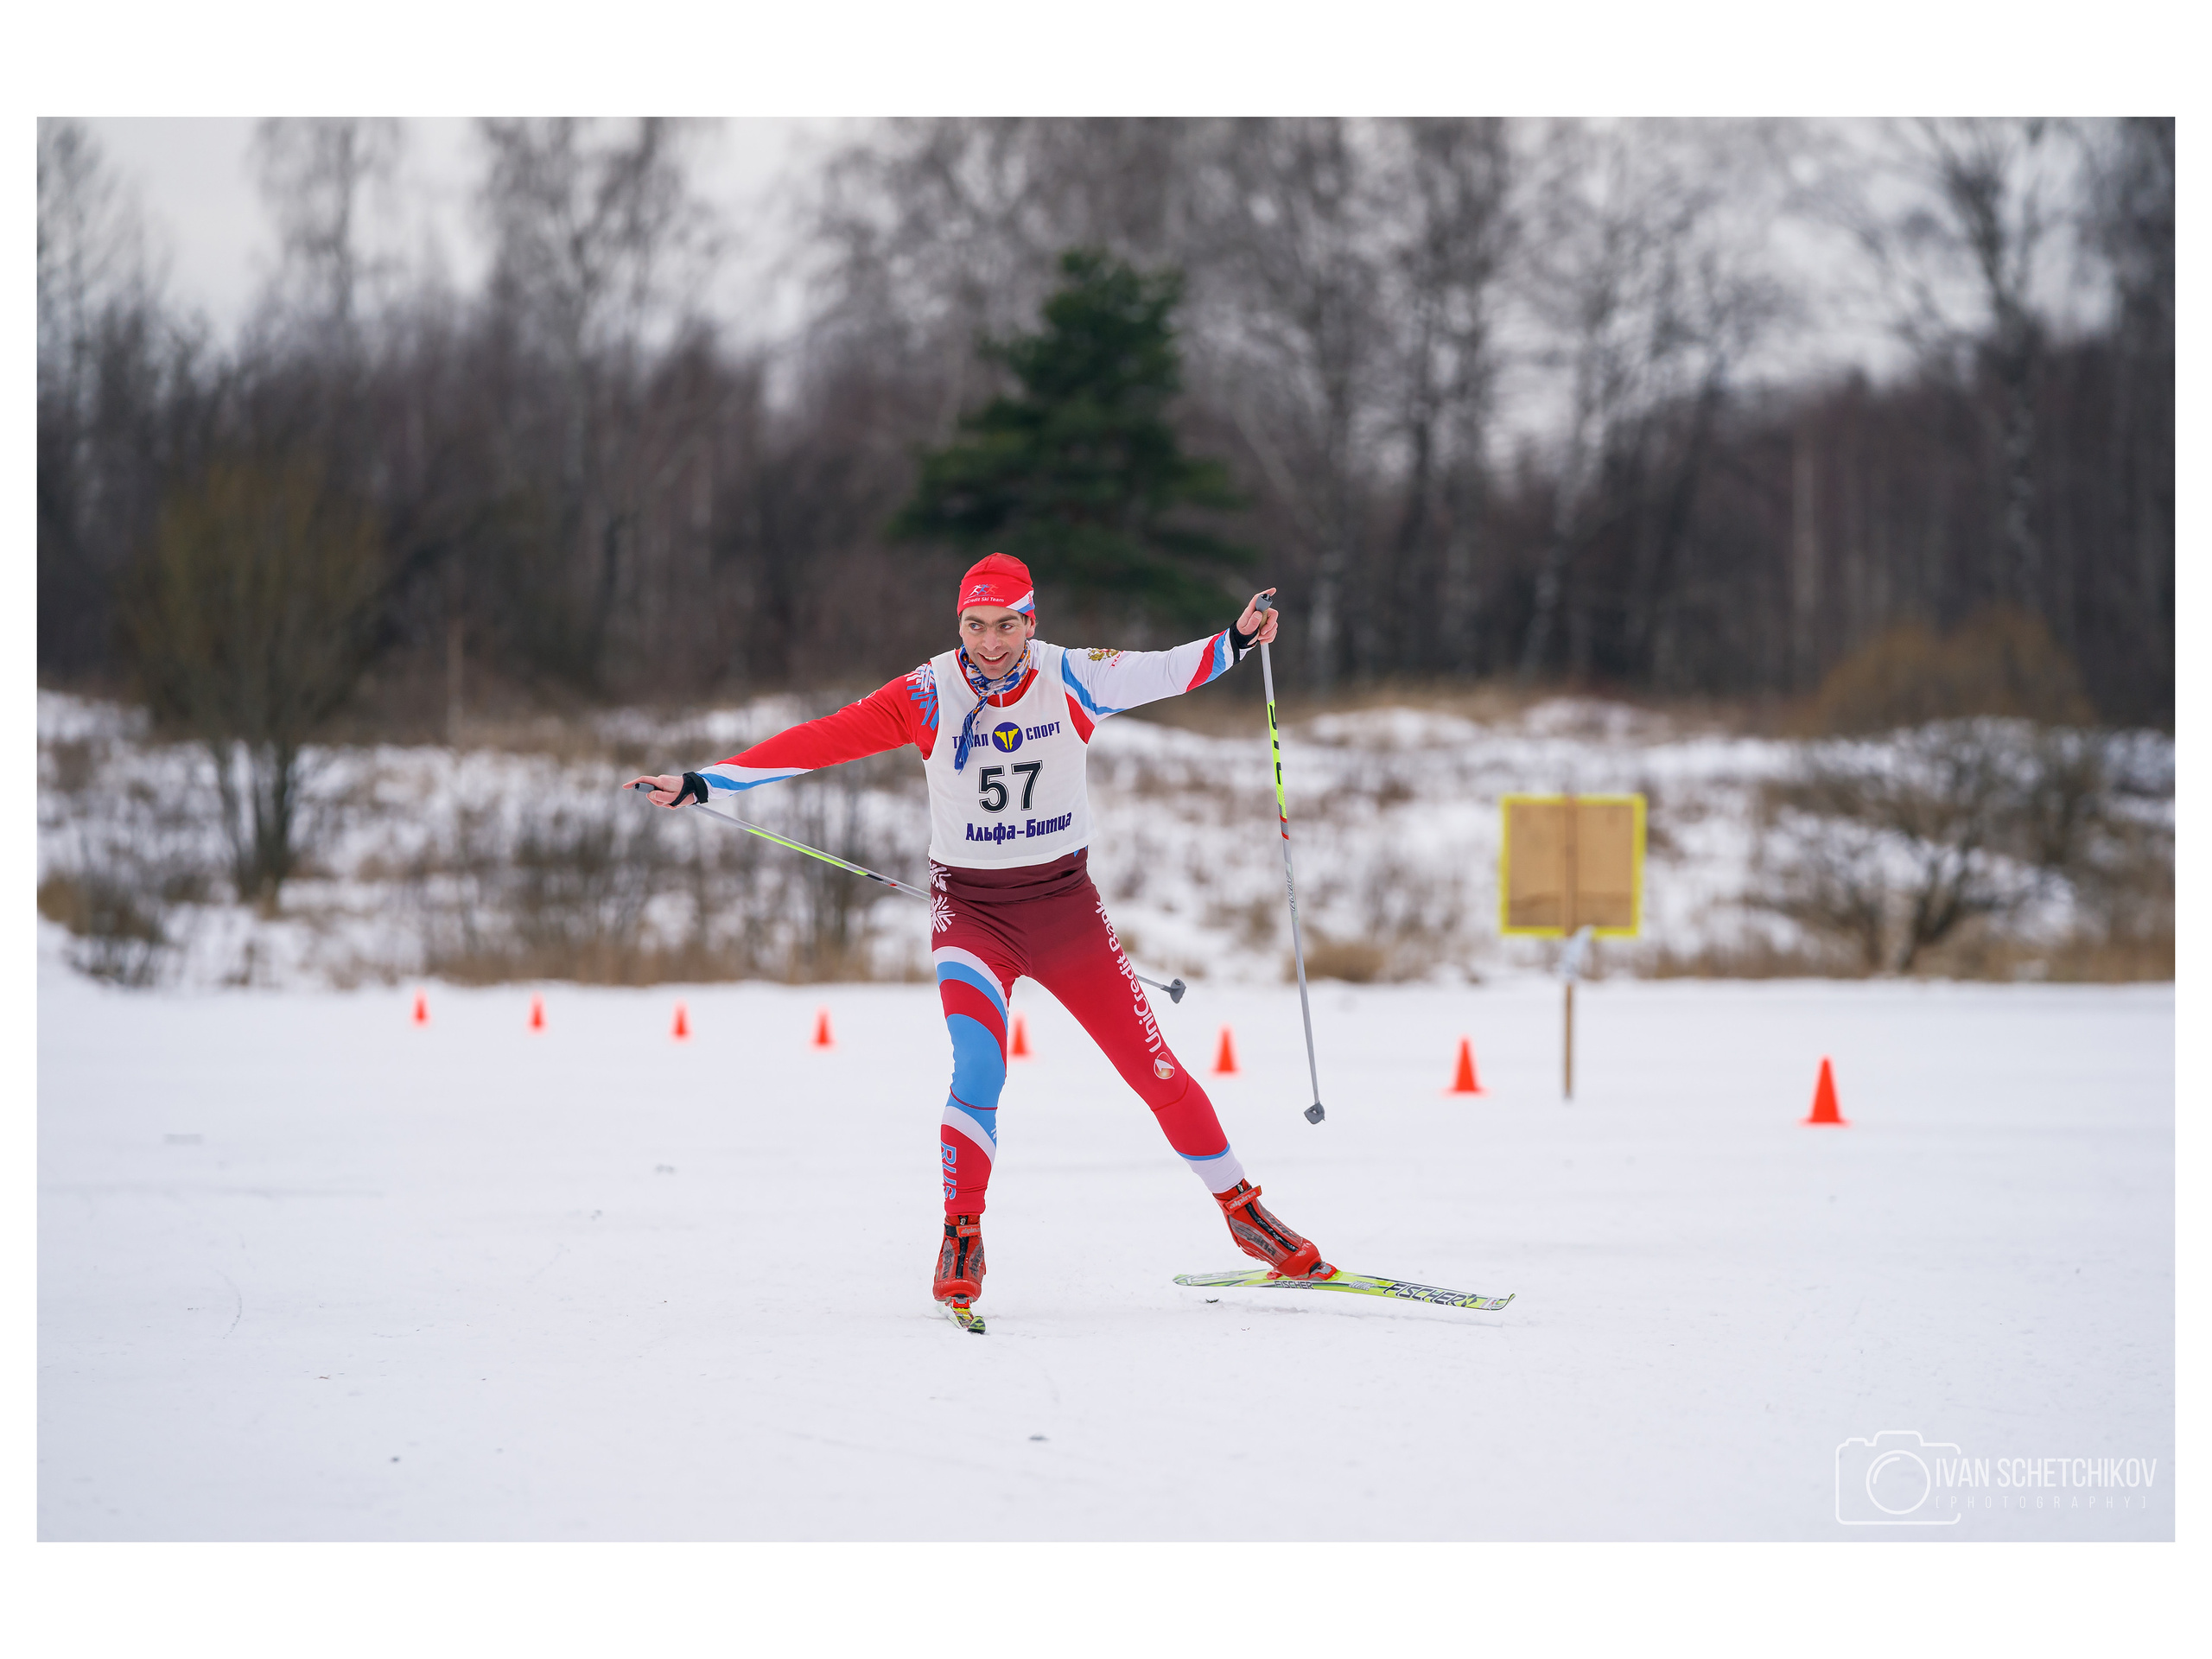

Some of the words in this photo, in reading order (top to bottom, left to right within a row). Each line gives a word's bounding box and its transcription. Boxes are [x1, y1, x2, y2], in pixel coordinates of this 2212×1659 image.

[952, 734, 989, 749] ТАЛ
[1026, 721, 1061, 741] СПОРТ
[979, 760, 1044, 813] 57
[965, 811, 1072, 845] Альфа-Битца
[1095, 900, 1121, 952] Bank
[1116, 952, 1162, 1053] UniCredit
[1229, 1191, 1257, 1210] alpina
[1274, 1280, 1315, 1290] FISCHER
[1382, 1282, 1467, 1307] FISCHER
